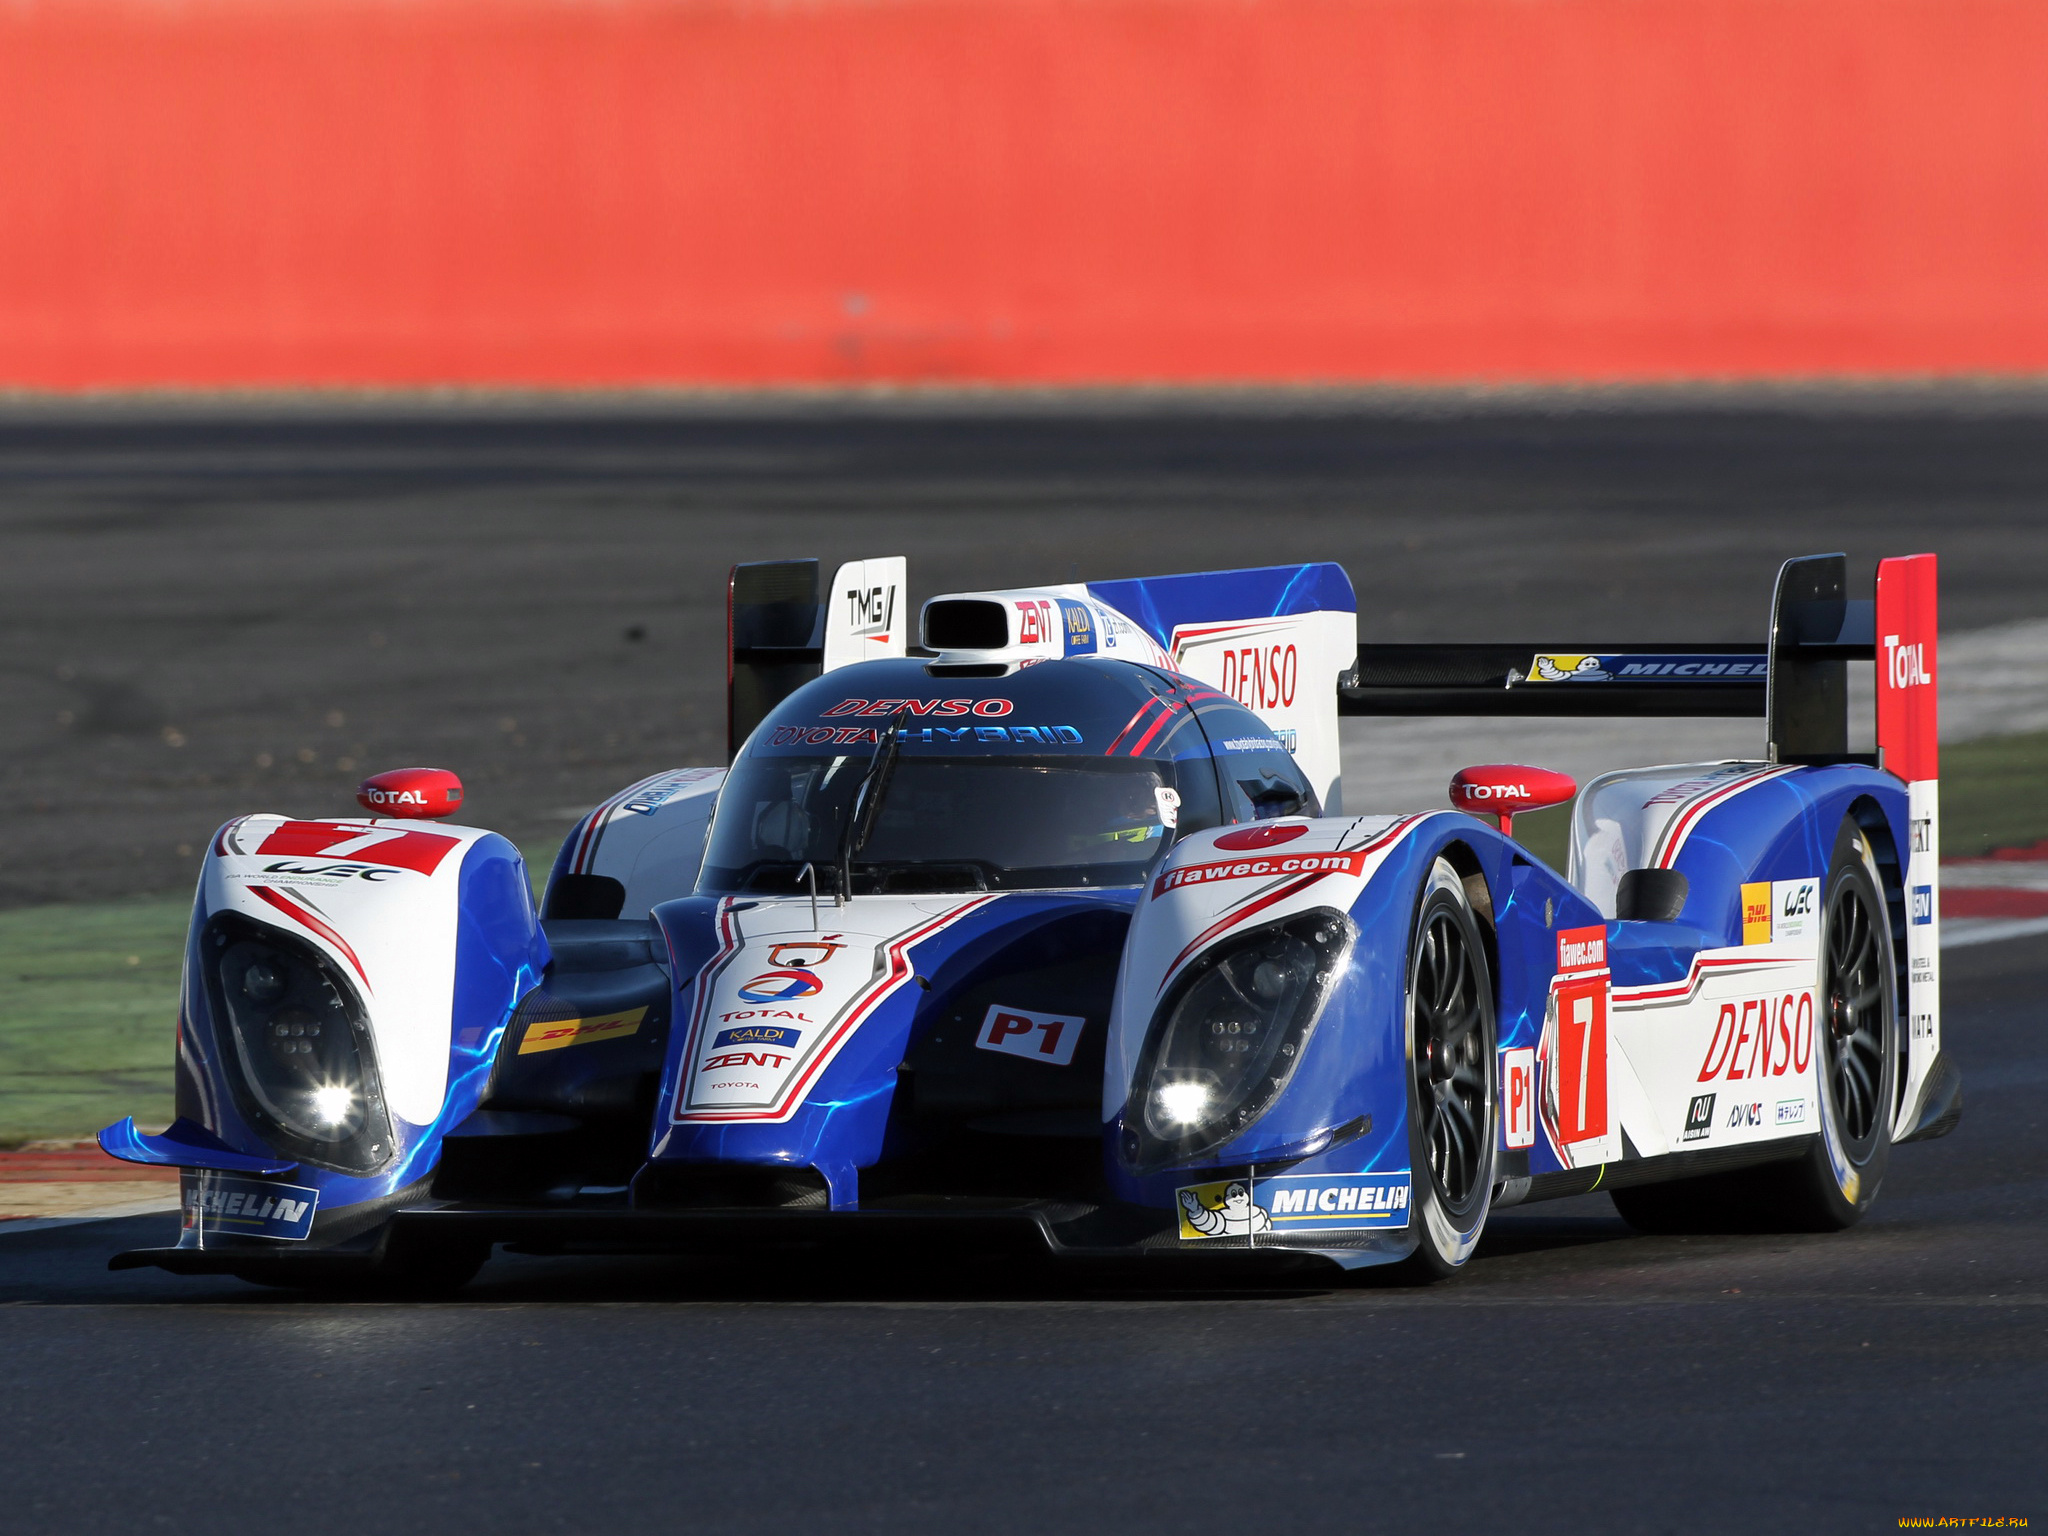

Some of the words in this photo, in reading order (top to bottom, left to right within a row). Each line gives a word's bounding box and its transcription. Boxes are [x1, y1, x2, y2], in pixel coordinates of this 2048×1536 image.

[847, 587, 882, 626] TMG
[1015, 601, 1051, 643] ZENT
[1065, 606, 1090, 633] KALDI
[1622, 663, 1768, 676] MICHEL
[1884, 635, 1930, 688] TOTAL
[1222, 644, 1297, 710] DENSO
[819, 698, 1014, 717] DENSO
[763, 725, 878, 747] TOYOTA
[896, 725, 1084, 744] HYBRID
[367, 788, 428, 804] TOTAL
[1462, 784, 1531, 799] TOTAL
[315, 825, 409, 857] 7
[262, 861, 402, 881] WEC
[263, 879, 339, 887] CHAMPIONSHIP
[279, 875, 344, 884] ENDURANCE
[1164, 855, 1352, 892] fiawec.com
[1784, 885, 1813, 917] WEC
[1747, 904, 1767, 923] DHL
[1560, 937, 1604, 968] fiawec.com
[719, 1009, 814, 1023] TOTAL
[539, 1020, 626, 1041] DHL
[730, 1028, 784, 1039] KALDI
[986, 1012, 1066, 1055] P1
[1696, 991, 1813, 1082] DENSO
[701, 1052, 792, 1073] ZENT
[1573, 996, 1593, 1132] 7
[711, 1081, 760, 1090] TOYOTA
[1510, 1066, 1530, 1134] P1
[1271, 1186, 1409, 1214] MICHELIN
